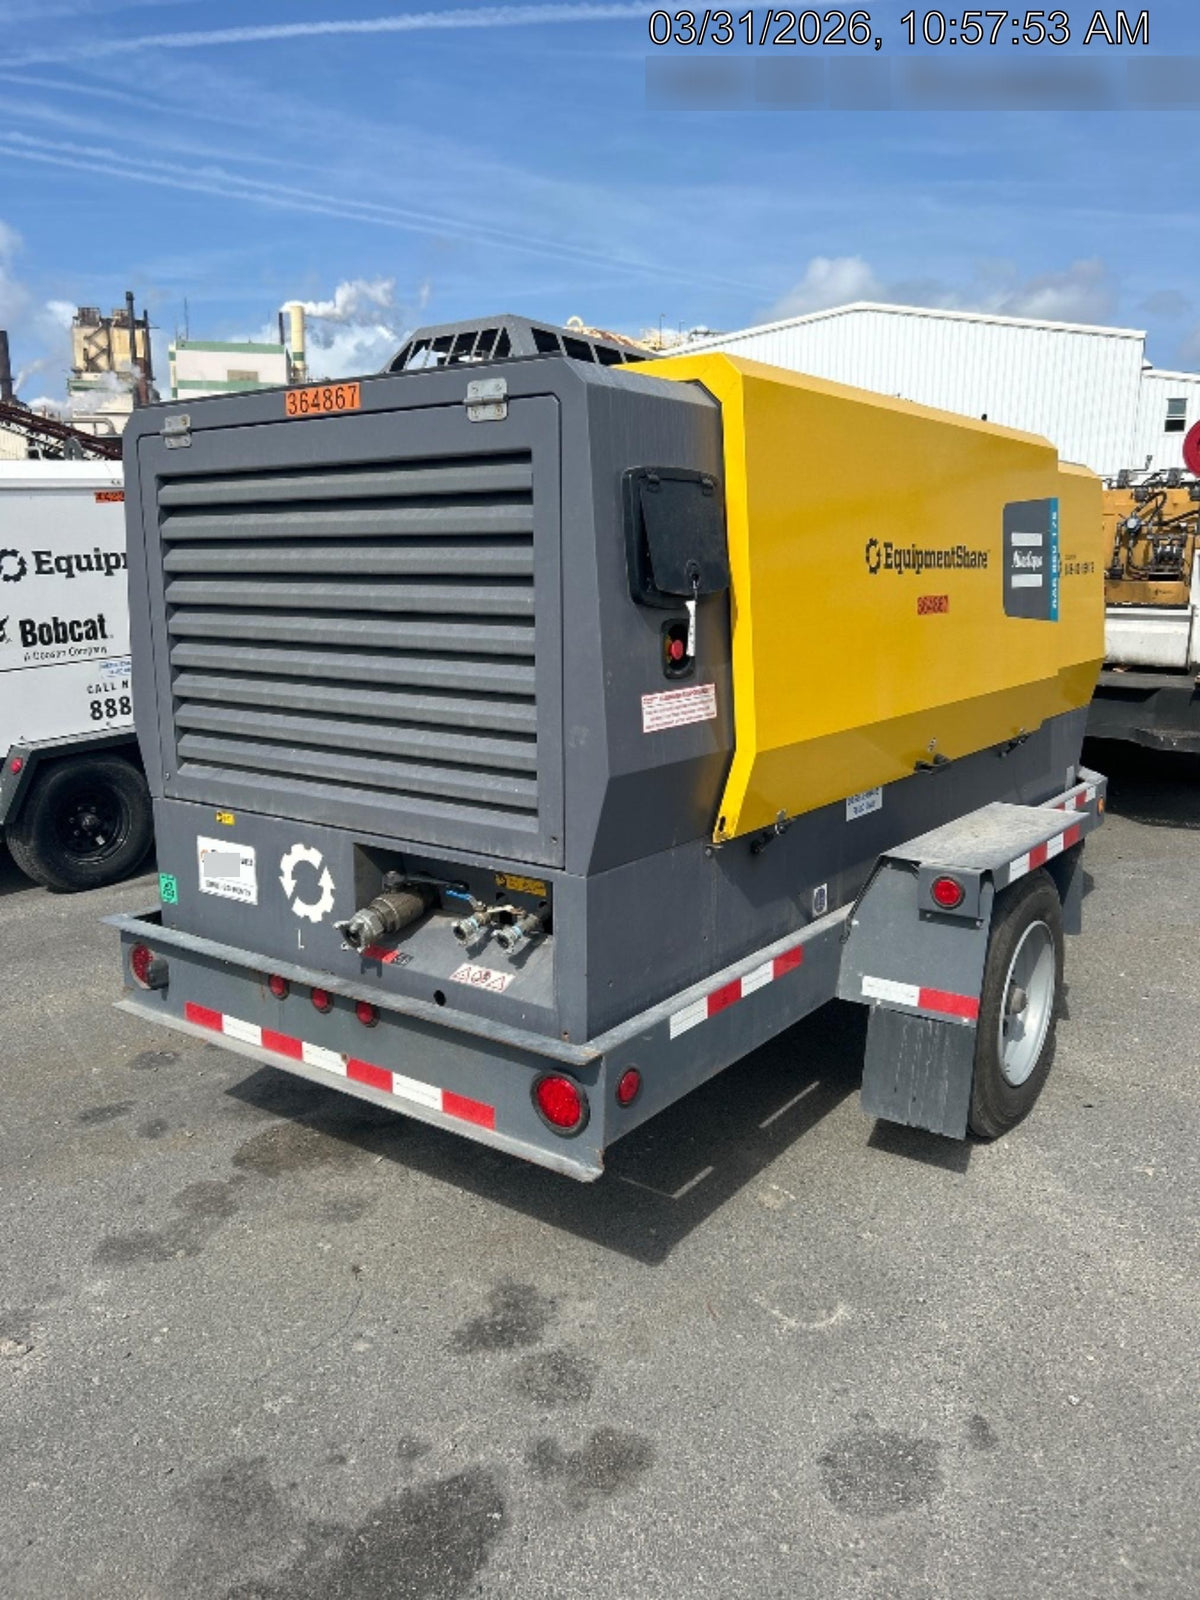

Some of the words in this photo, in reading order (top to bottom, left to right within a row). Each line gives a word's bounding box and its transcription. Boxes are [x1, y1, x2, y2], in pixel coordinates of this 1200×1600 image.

[287, 385, 356, 415] 364867
[883, 542, 988, 575] EquipmentShare
[19, 613, 108, 647] Bobcat
[87, 682, 117, 694] CALL
